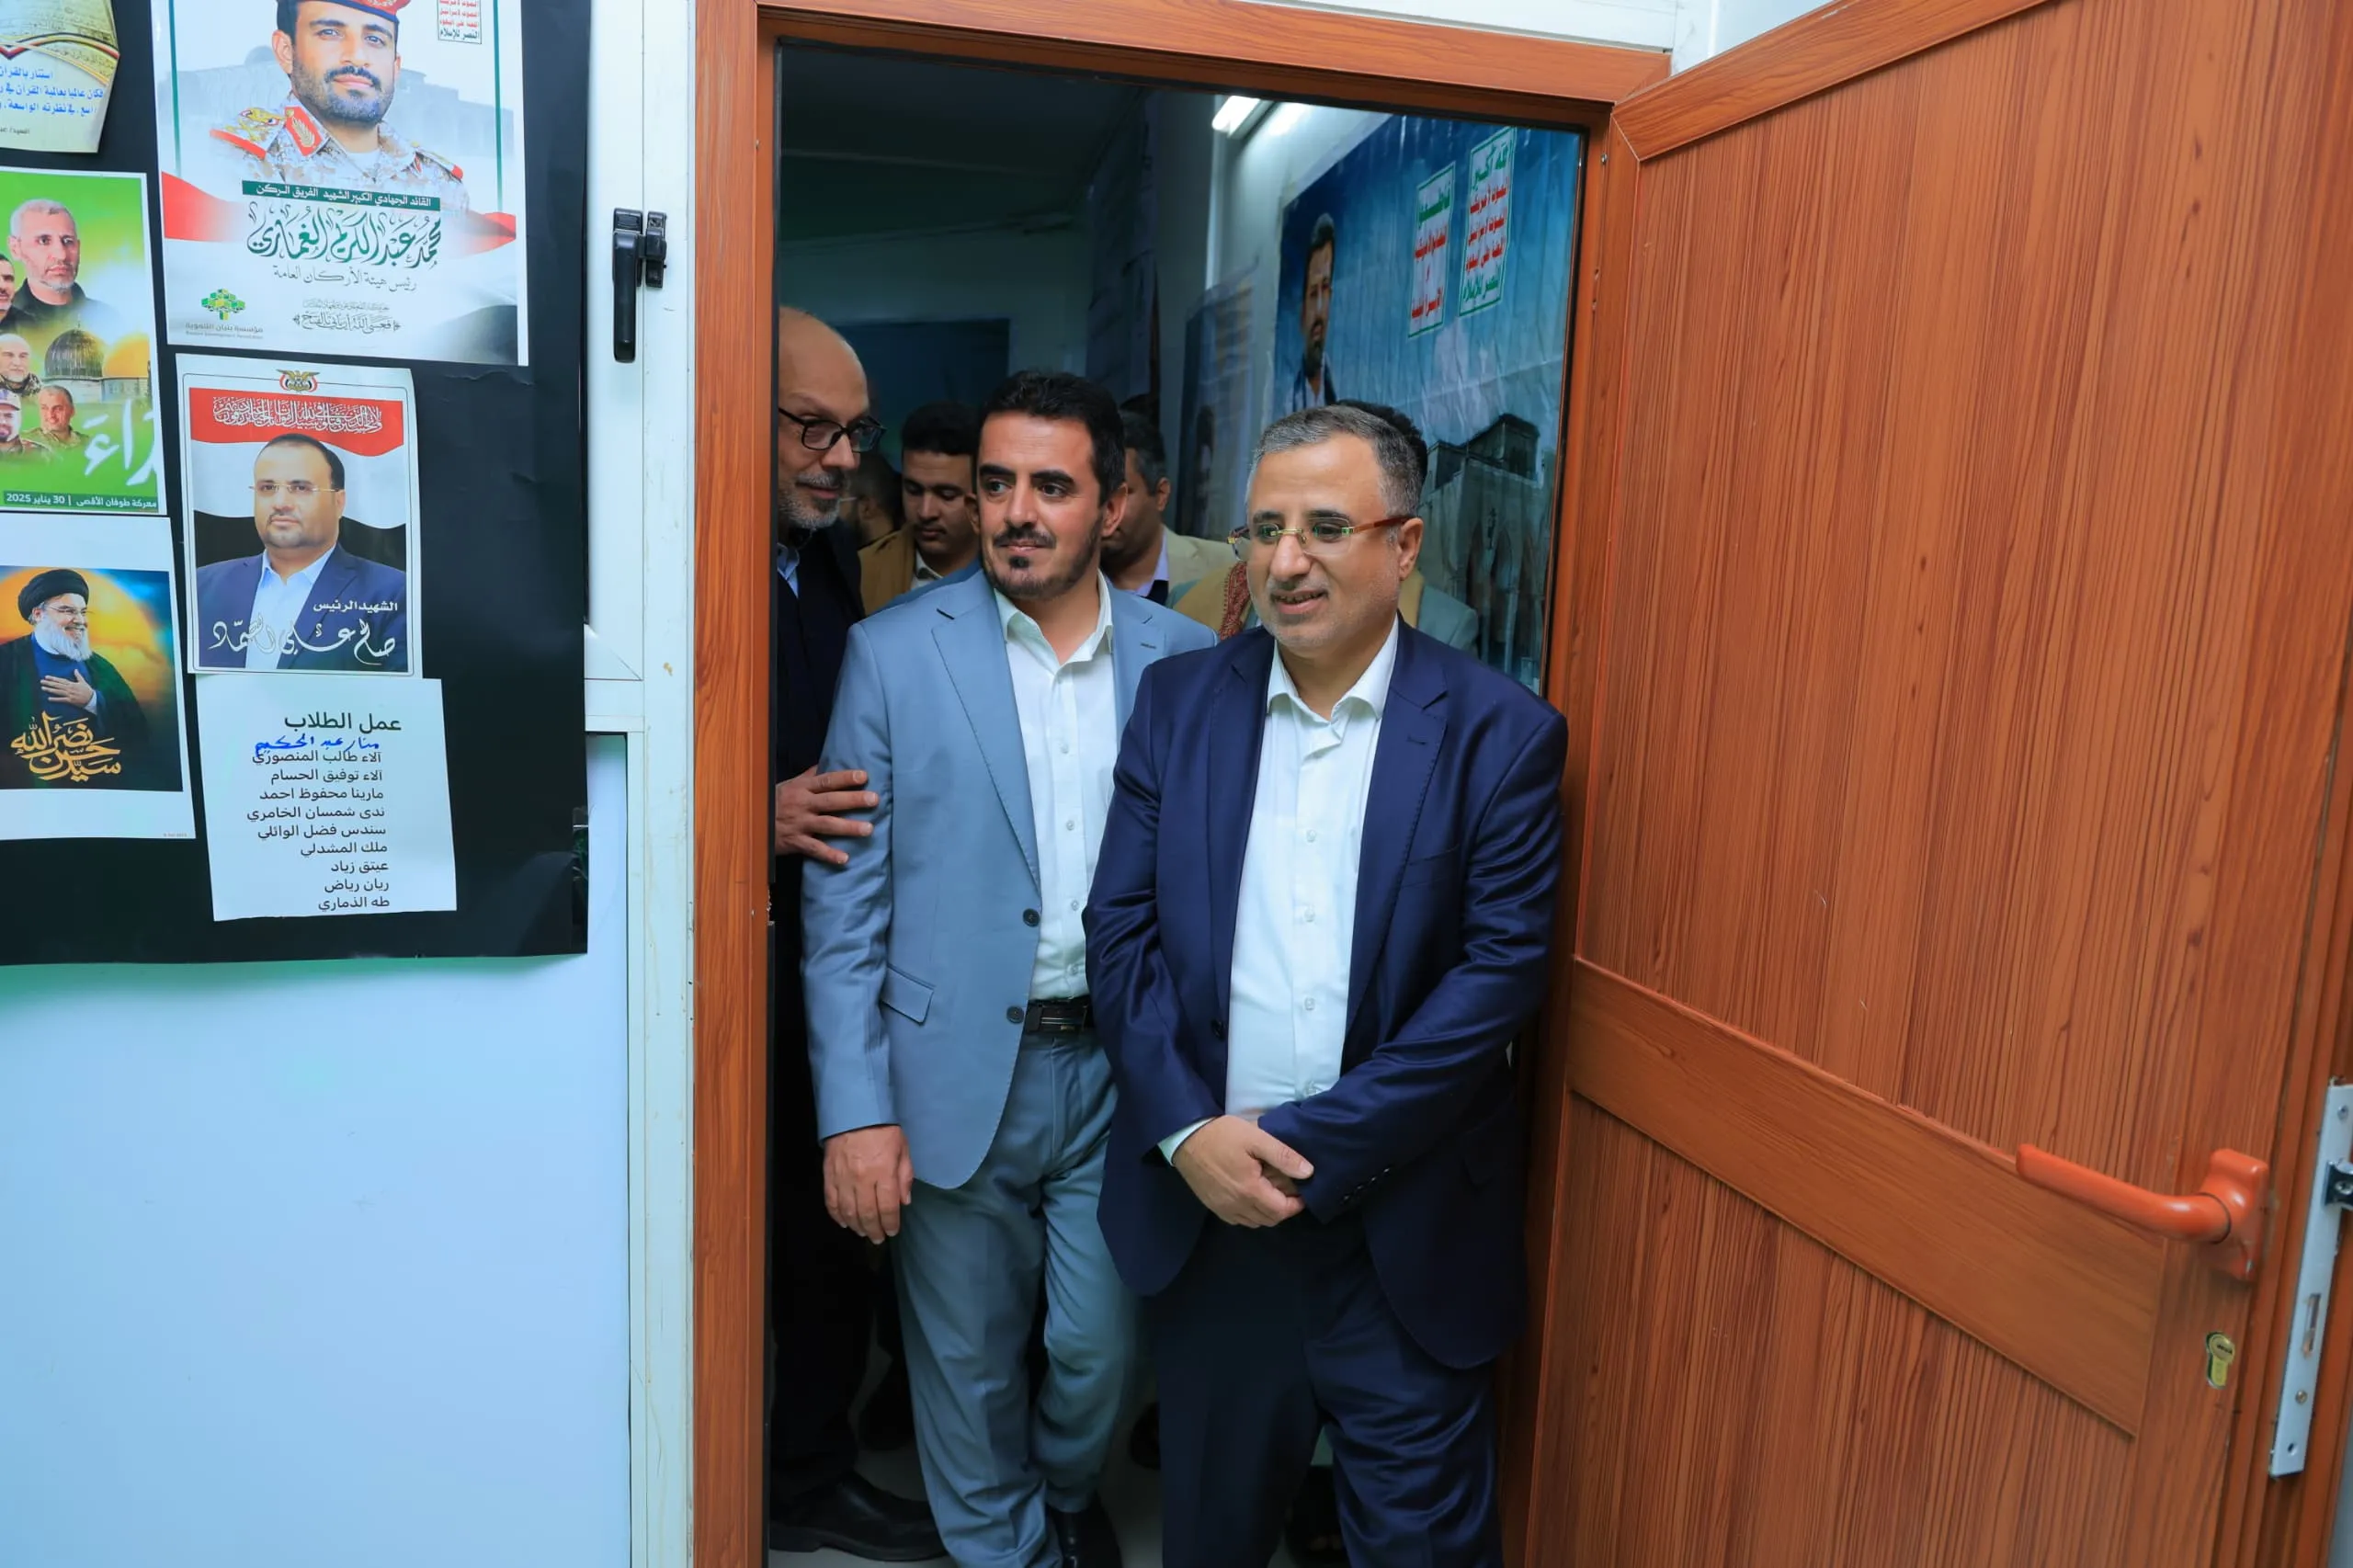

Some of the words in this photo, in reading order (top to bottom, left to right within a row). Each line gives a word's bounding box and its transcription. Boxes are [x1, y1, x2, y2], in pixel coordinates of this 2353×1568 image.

[292, 187, 319, 199] الفريق
[323, 189, 350, 201] الشهيد
[351, 191, 373, 205] الكبير
[374, 193, 408, 208] الجهادي
[409, 196, 433, 208] القائد
[273, 264, 301, 280] العامة
[303, 266, 363, 287] الأركان
[364, 272, 387, 287] هيئة
[388, 276, 417, 292] رئيس
[6, 493, 31, 503] 2025
[33, 494, 51, 506] يناير
[53, 494, 65, 504] 30
[75, 495, 104, 506] الأقصى
[105, 497, 131, 507] طوفان
[131, 498, 157, 508] معركة
[284, 711, 352, 733] الطلاب
[359, 712, 402, 734] عمل
[255, 733, 315, 757] الحكيم
[320, 736, 344, 751] عبد
[252, 749, 319, 767] المنصوري
[323, 750, 358, 765] طالب
[361, 751, 381, 763] آلاء
[270, 768, 319, 786] الحسام
[323, 769, 359, 783] توفيق
[362, 769, 382, 781] آلاء
[259, 788, 294, 800] احمد
[299, 788, 347, 802] محفوظ
[351, 788, 384, 801] مارينا
[246, 806, 301, 823] الخامري
[305, 806, 356, 821] شمسان
[359, 809, 385, 820] ندى
[257, 824, 300, 842] الوائلي
[303, 823, 337, 839] فضل
[341, 826, 387, 838] سندس
[300, 841, 358, 858] المشدلي
[360, 841, 388, 854] ملك
[330, 860, 356, 874] زياد
[324, 878, 360, 893] رياض
[363, 878, 390, 892] ريان
[318, 896, 368, 913] الذماري
[371, 895, 391, 908] طه
